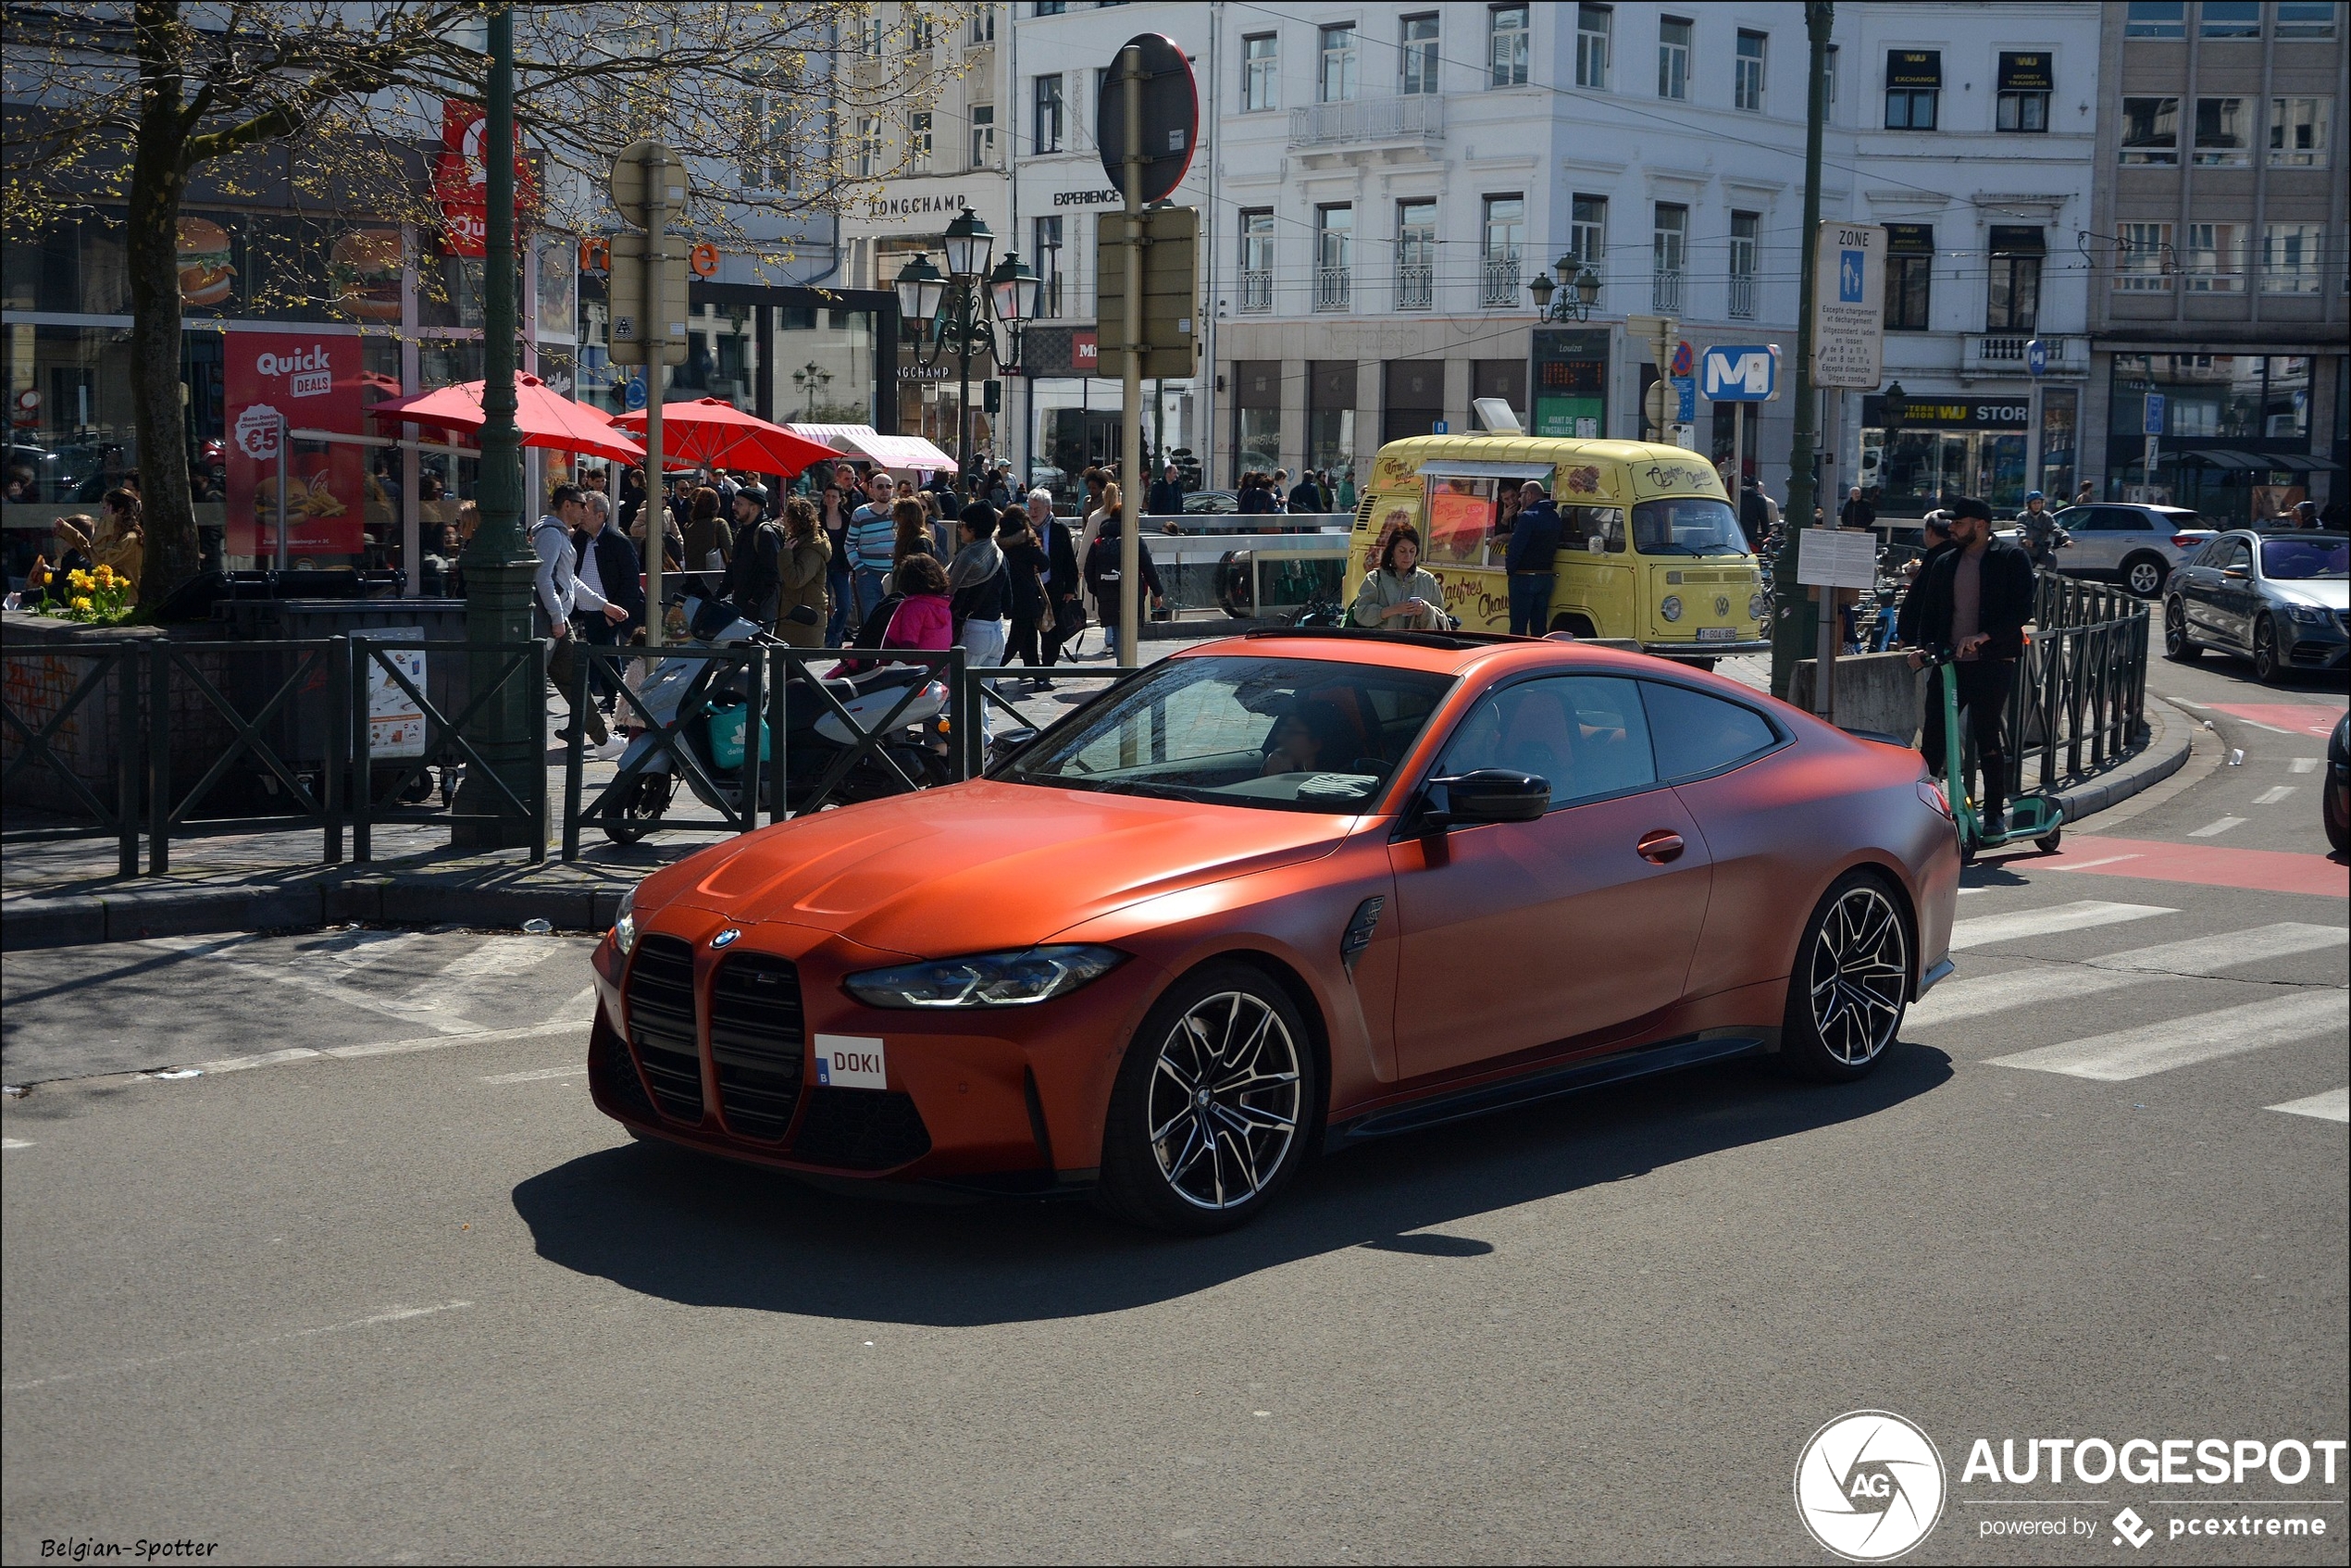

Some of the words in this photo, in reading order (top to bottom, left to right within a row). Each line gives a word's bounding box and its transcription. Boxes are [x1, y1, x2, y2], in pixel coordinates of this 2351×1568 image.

[1054, 188, 1121, 205] EXPERIENCE
[871, 194, 966, 217] LONGCHAMP
[1839, 230, 1870, 247] ZONE
[1846, 307, 1878, 317] chargement
[1559, 343, 1583, 353] Louiza
[256, 344, 330, 377] Quick
[2030, 351, 2044, 366] M
[896, 367, 950, 379] NGCHAMP
[297, 377, 329, 392] DEALS
[1976, 405, 2028, 421] STOR
[1549, 417, 1564, 425] AVANT
[1566, 417, 1573, 425] DE
[1541, 426, 1573, 435] T'INSTALLER
[245, 427, 278, 453] €5
[1478, 592, 1510, 618] Chau
[834, 1052, 880, 1073] DOKI
[820, 1073, 827, 1082] B
